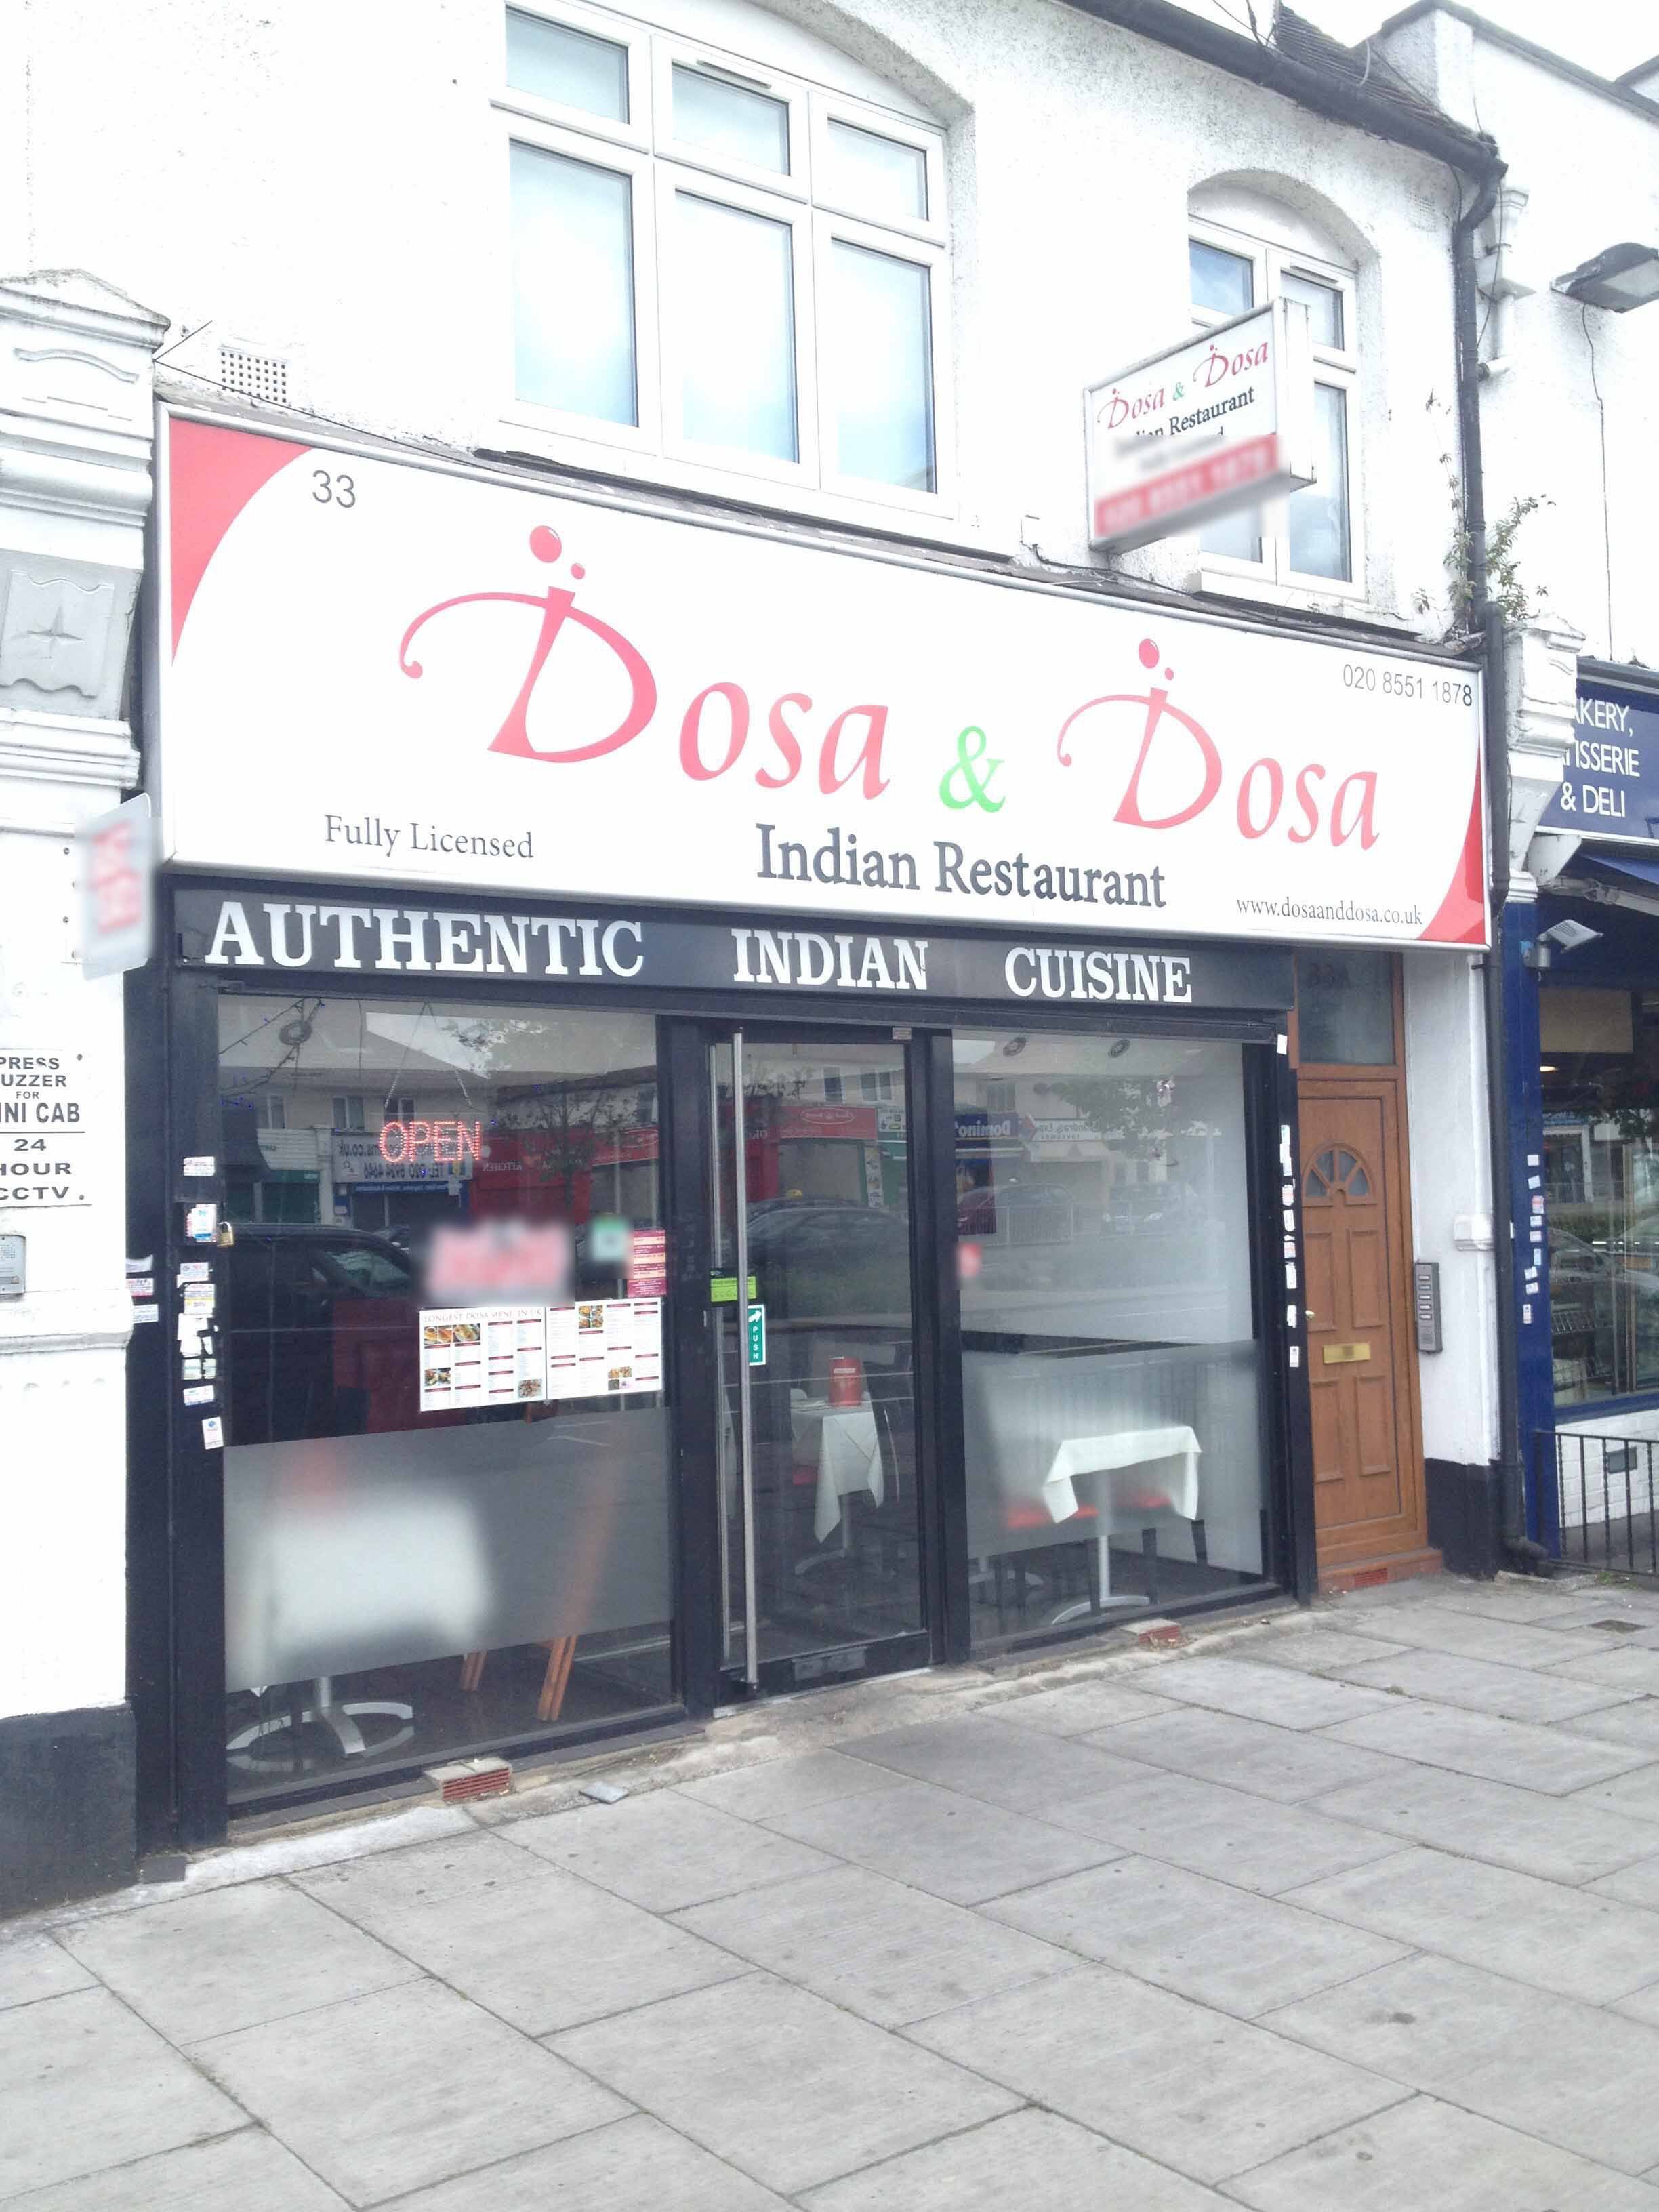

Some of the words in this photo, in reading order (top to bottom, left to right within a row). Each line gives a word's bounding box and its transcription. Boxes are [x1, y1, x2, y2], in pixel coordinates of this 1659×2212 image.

[1097, 388, 1164, 429] Dosa
[1172, 382, 1185, 401] &
[1193, 342, 1268, 388] Dosa
[1169, 386, 1254, 436] Restaurant
[312, 470, 356, 508] 33
[400, 525, 890, 800] Dosa
[939, 726, 1006, 813] &
[1057, 638, 1380, 851] Dosa
[1343, 664, 1376, 691] 020
[1382, 672, 1424, 699] 8551
[1431, 680, 1473, 707] 1878
[1574, 697, 1633, 737] KERY,
[1561, 782, 1576, 811] &
[1582, 785, 1625, 817] DELI
[325, 815, 401, 857] Fully
[410, 823, 535, 859] Licensed
[756, 823, 920, 890] Indian
[934, 841, 1167, 909] Restaurant
[1236, 897, 1423, 926] www.dosaanddosa.co.uk
[205, 901, 644, 977] AUTHENTIC
[731, 928, 928, 990] INDIAN
[1004, 947, 1193, 1003] CUISINE
[1, 1074, 67, 1087] UZZER
[16, 1091, 39, 1099] FOR
[0, 1103, 26, 1123] NI
[36, 1102, 81, 1123] CAB
[14, 1139, 47, 1151] 24
[379, 1120, 482, 1163] OPEN
